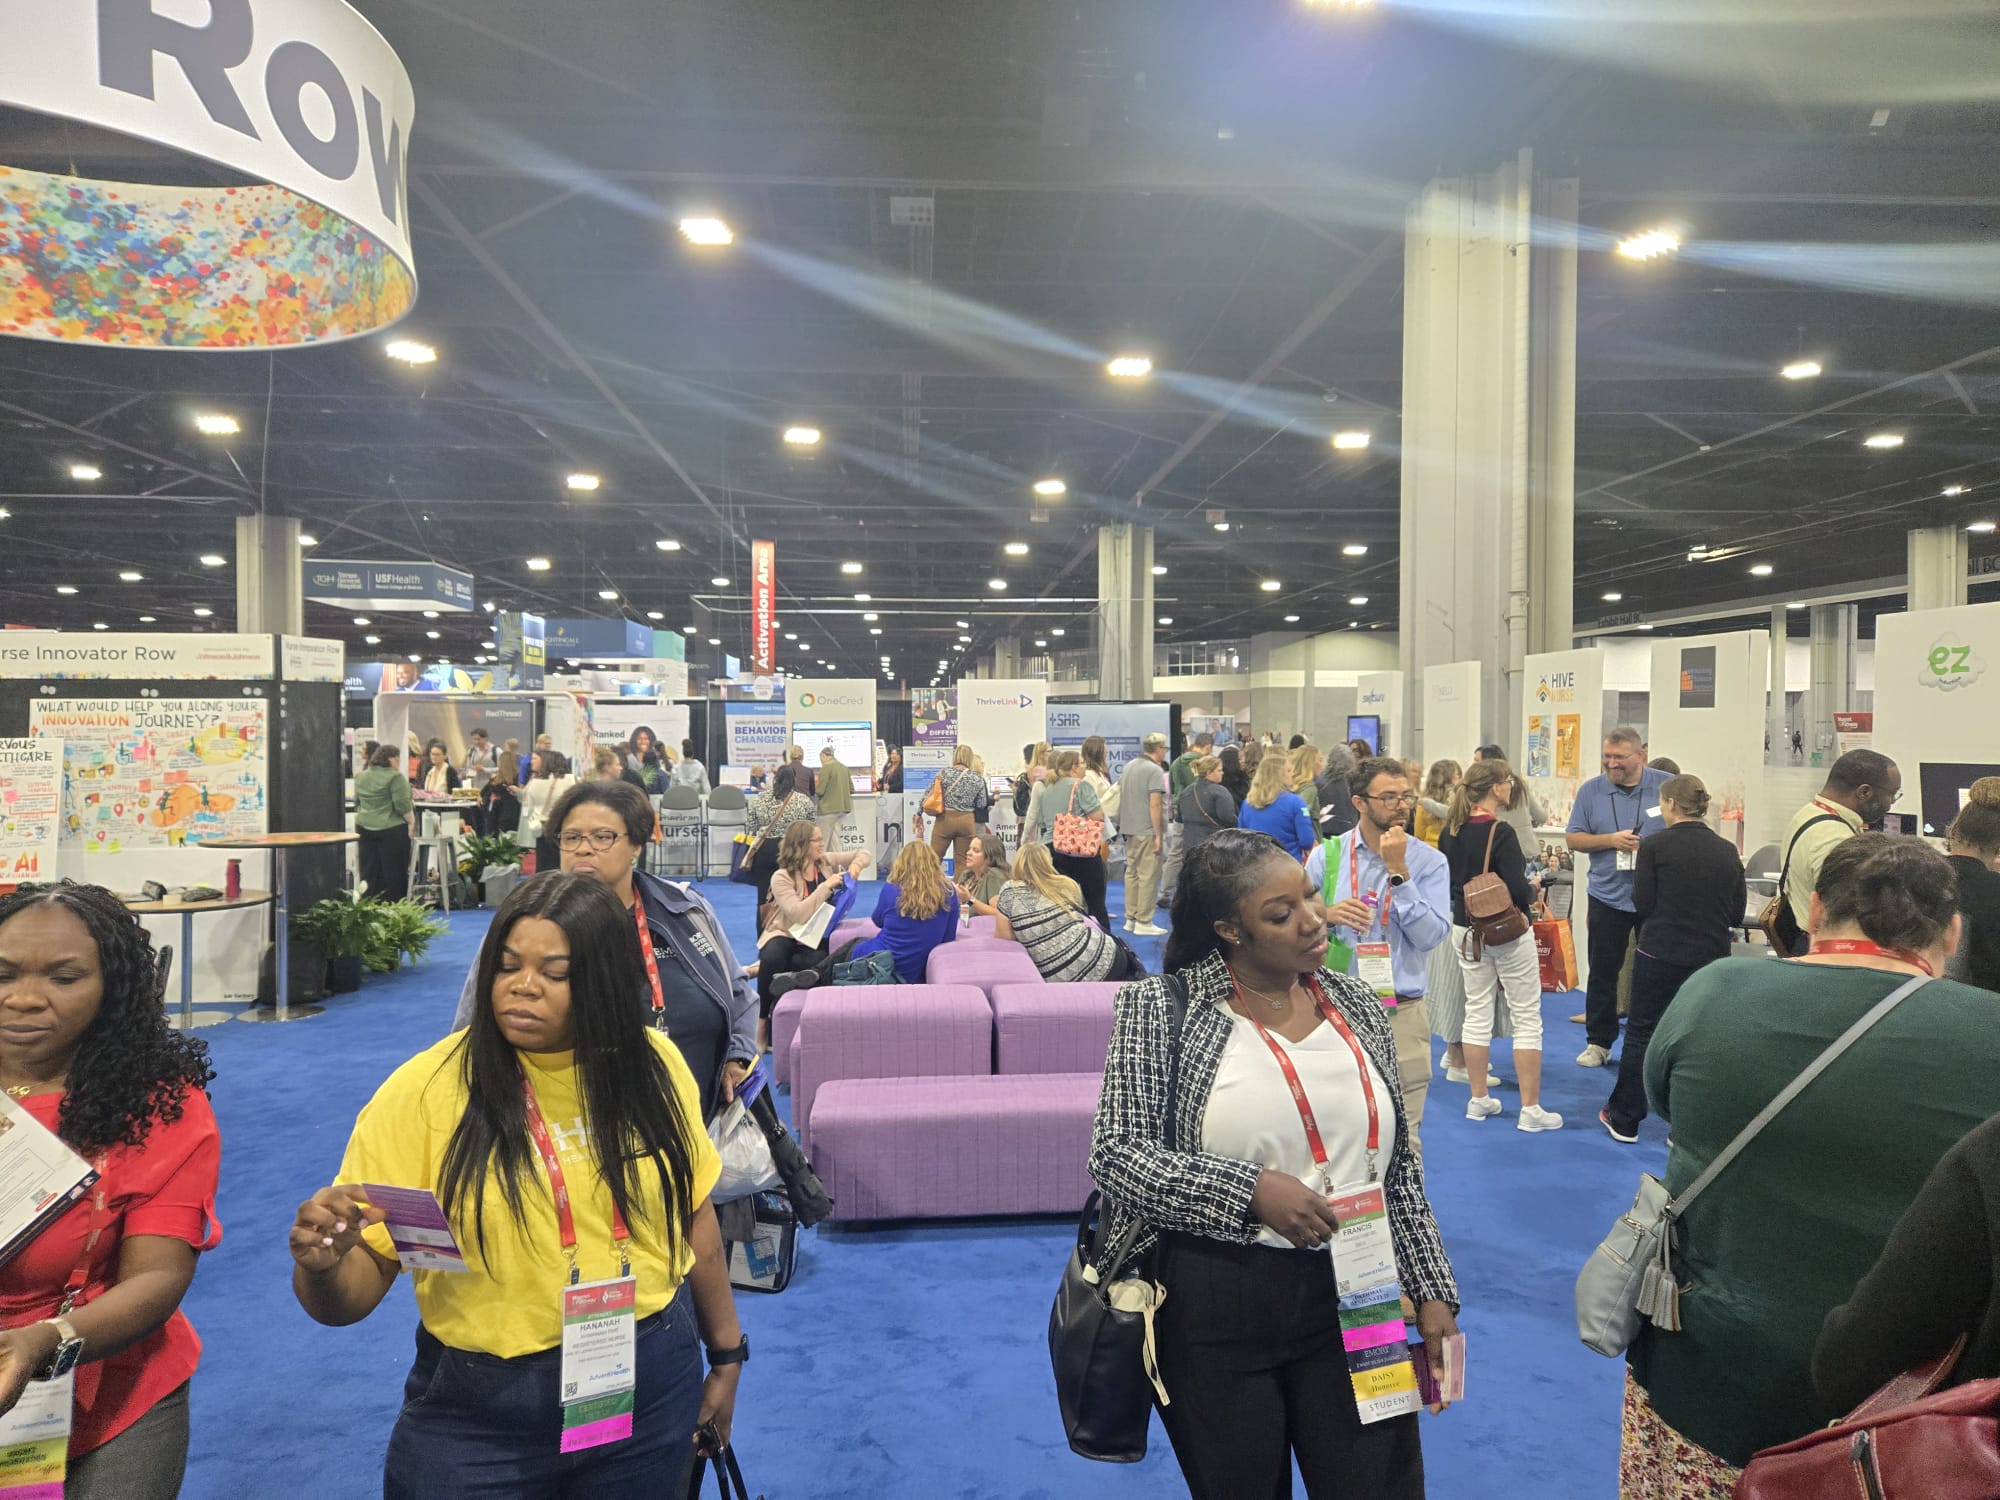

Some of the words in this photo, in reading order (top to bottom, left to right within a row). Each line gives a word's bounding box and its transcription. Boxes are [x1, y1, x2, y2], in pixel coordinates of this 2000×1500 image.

[757, 547, 769, 586] Area
[757, 588, 769, 670] Activation
[36, 645, 128, 661] Innovator
[135, 646, 176, 661] Row
[1928, 645, 1971, 676] ez
[1551, 672, 1575, 688] HIVE
[36, 700, 72, 713] WHAT
[76, 700, 119, 713] WOULD
[125, 700, 155, 713] HELP
[187, 700, 223, 713] ALONG
[226, 700, 258, 713] YOUR
[816, 695, 864, 706] OneCred
[976, 697, 1018, 706] ThriveLink
[41, 714, 130, 727] INNOVATION
[134, 712, 220, 729] JOURNEY?
[593, 729, 626, 739] Ranked
[735, 726, 787, 735] BEHAVIOR
[14, 851, 38, 873] AI
[1342, 1222, 1373, 1237] FRANCIS
[580, 1318, 621, 1332] HANANAH
[1364, 1345, 1390, 1358] EMORY
[1371, 1371, 1395, 1383] DAISY
[1371, 1381, 1401, 1393] Honoree
[1369, 1395, 1411, 1412] STUDENT
